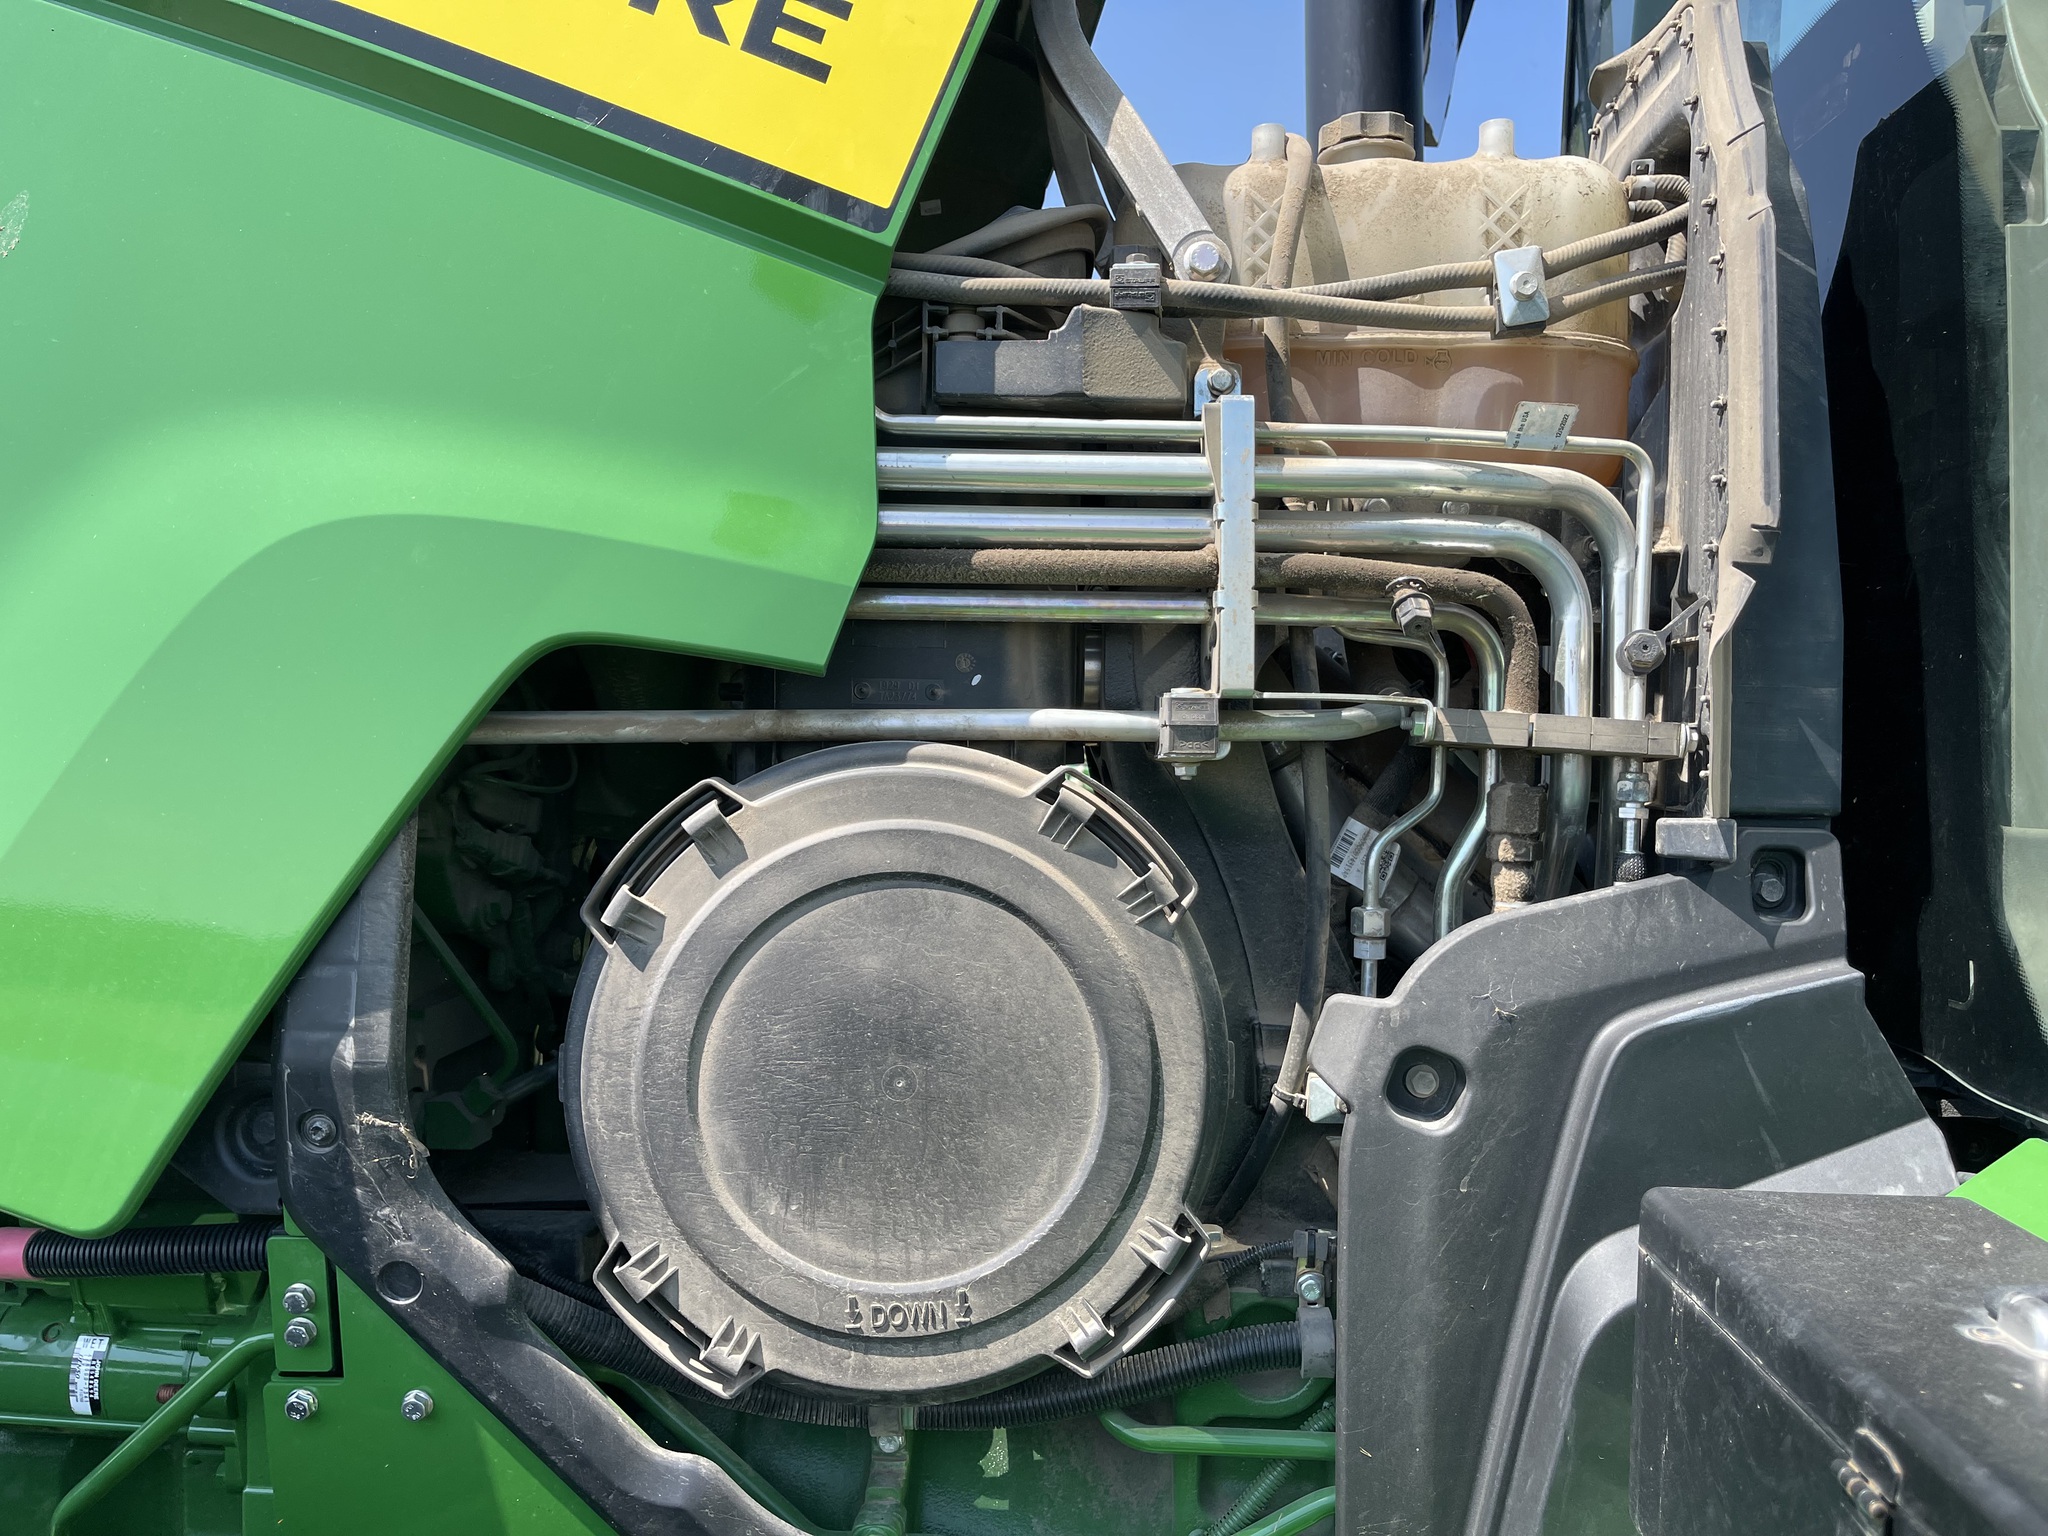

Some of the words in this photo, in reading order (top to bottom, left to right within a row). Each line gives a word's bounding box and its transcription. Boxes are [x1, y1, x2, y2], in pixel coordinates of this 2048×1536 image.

[1315, 350, 1353, 366] MIN
[1361, 348, 1419, 365] COLD
[1521, 410, 1530, 423] USA
[870, 1300, 948, 1331] DOWN
[83, 1338, 104, 1349] WET
